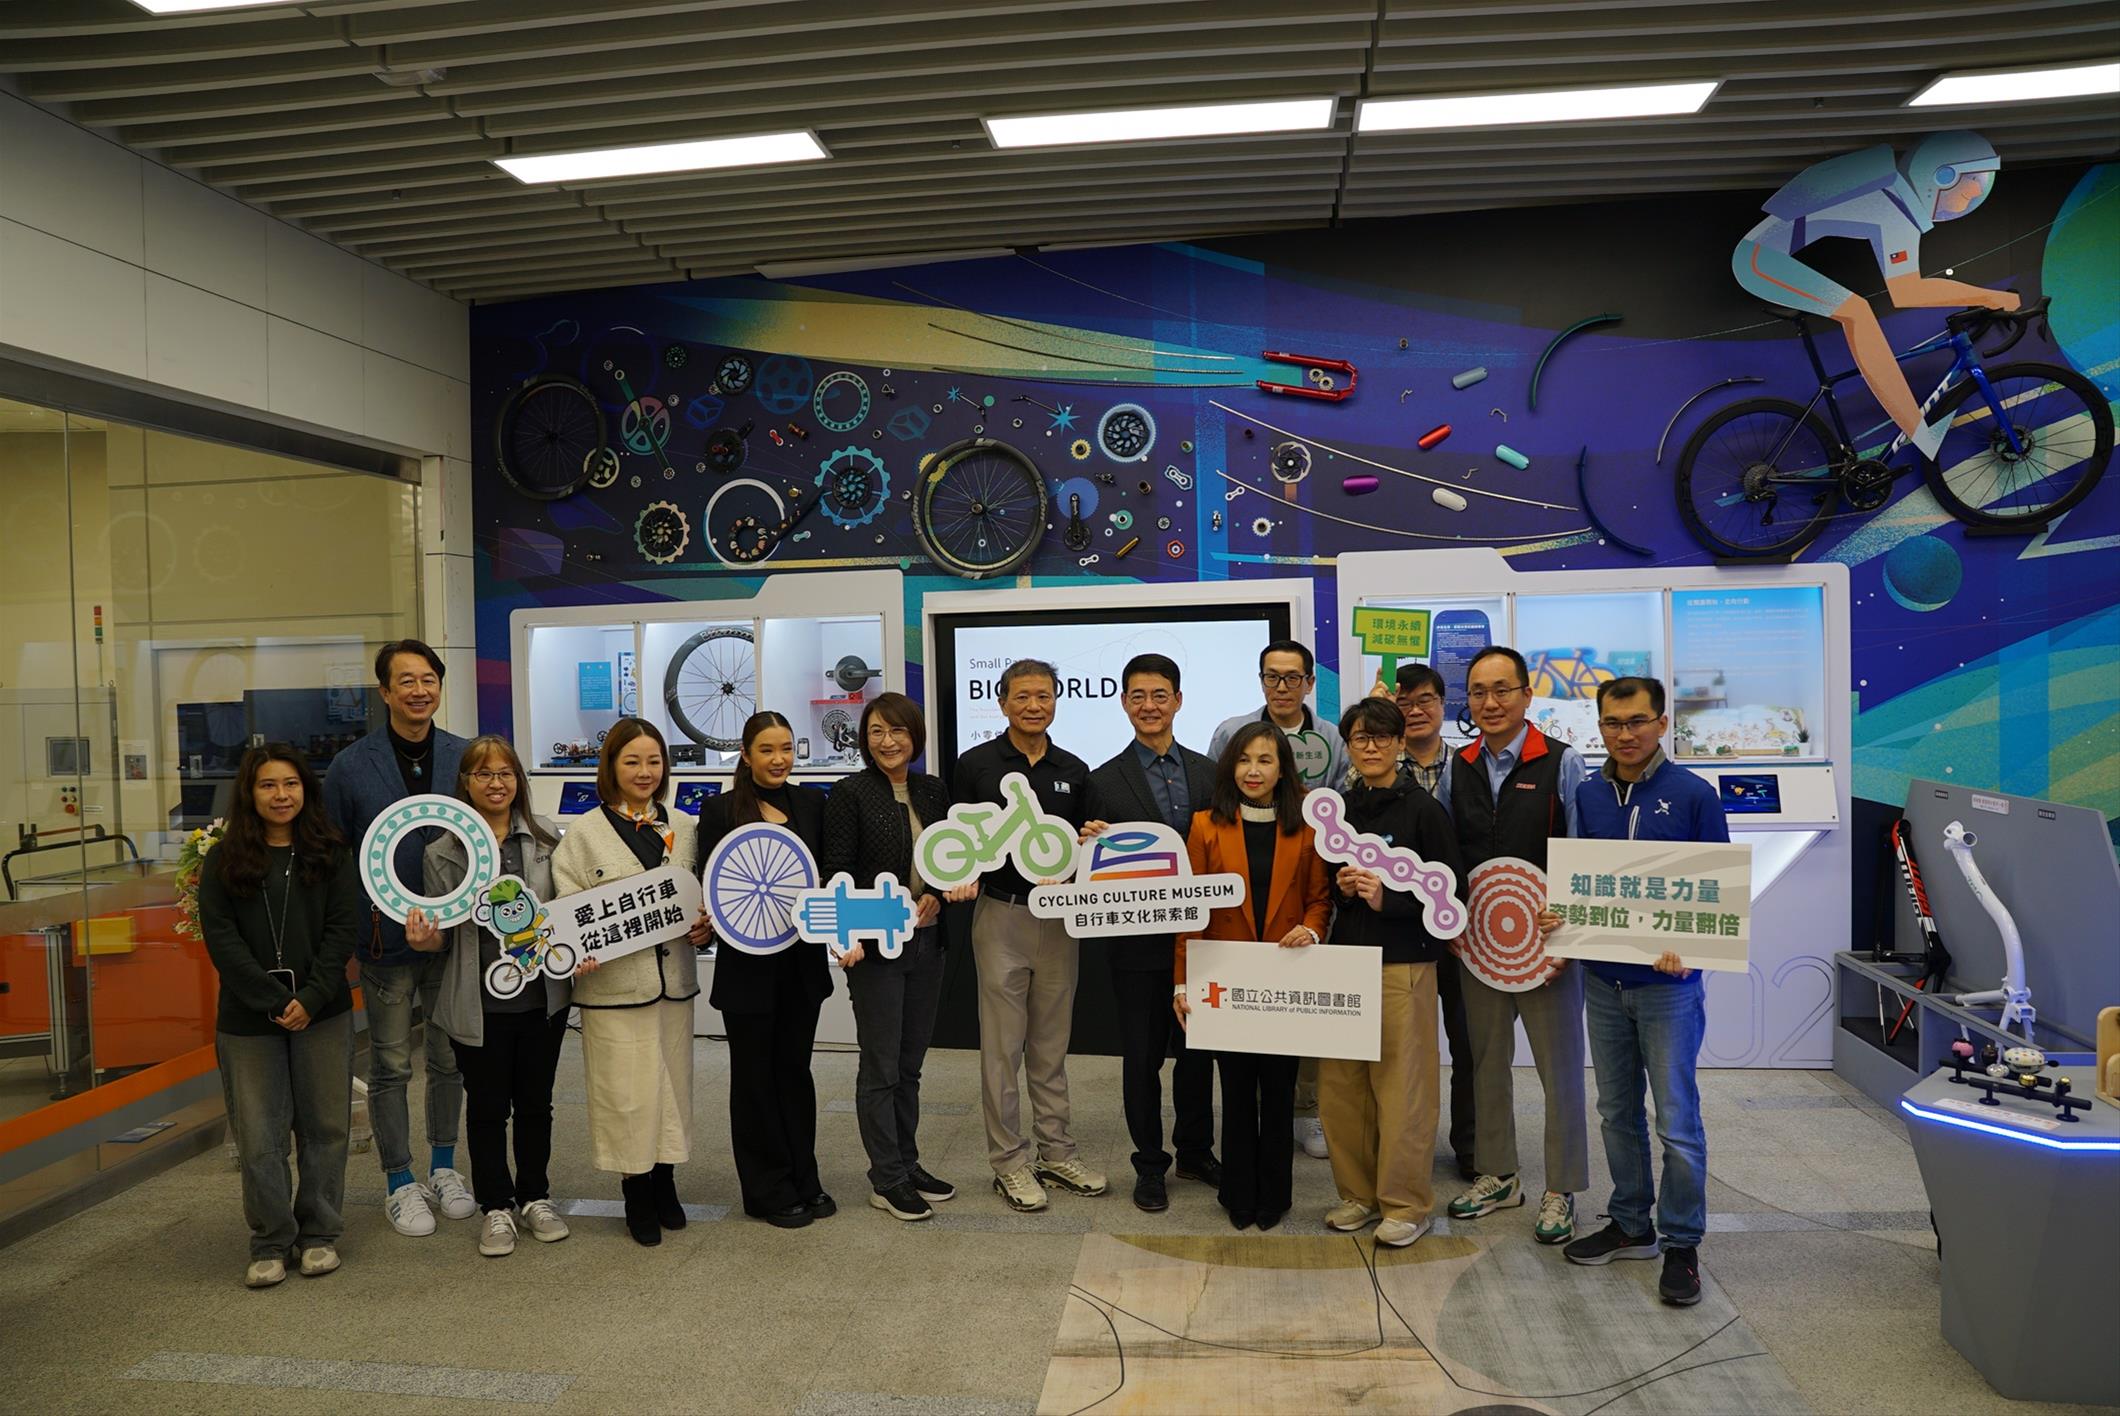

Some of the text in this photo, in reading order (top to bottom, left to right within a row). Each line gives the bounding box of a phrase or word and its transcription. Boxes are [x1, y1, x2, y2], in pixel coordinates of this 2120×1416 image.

[969, 658, 1001, 670] Small
[1038, 884, 1235, 908] CYCLING CULTURE MUSEUM
[1570, 873, 1720, 904] 知識就是力量
[574, 878, 678, 928] 愛上自行車
[1075, 906, 1199, 927] 自行車文化探索館
[580, 904, 685, 953] 從這裡開始
[1231, 987, 1361, 1008] 國立公共資訊圖書館
[1232, 1003, 1261, 1012] NATIONAL
[1262, 1005, 1288, 1013] LIBRARY
[1318, 1008, 1361, 1016] INFORMATION
